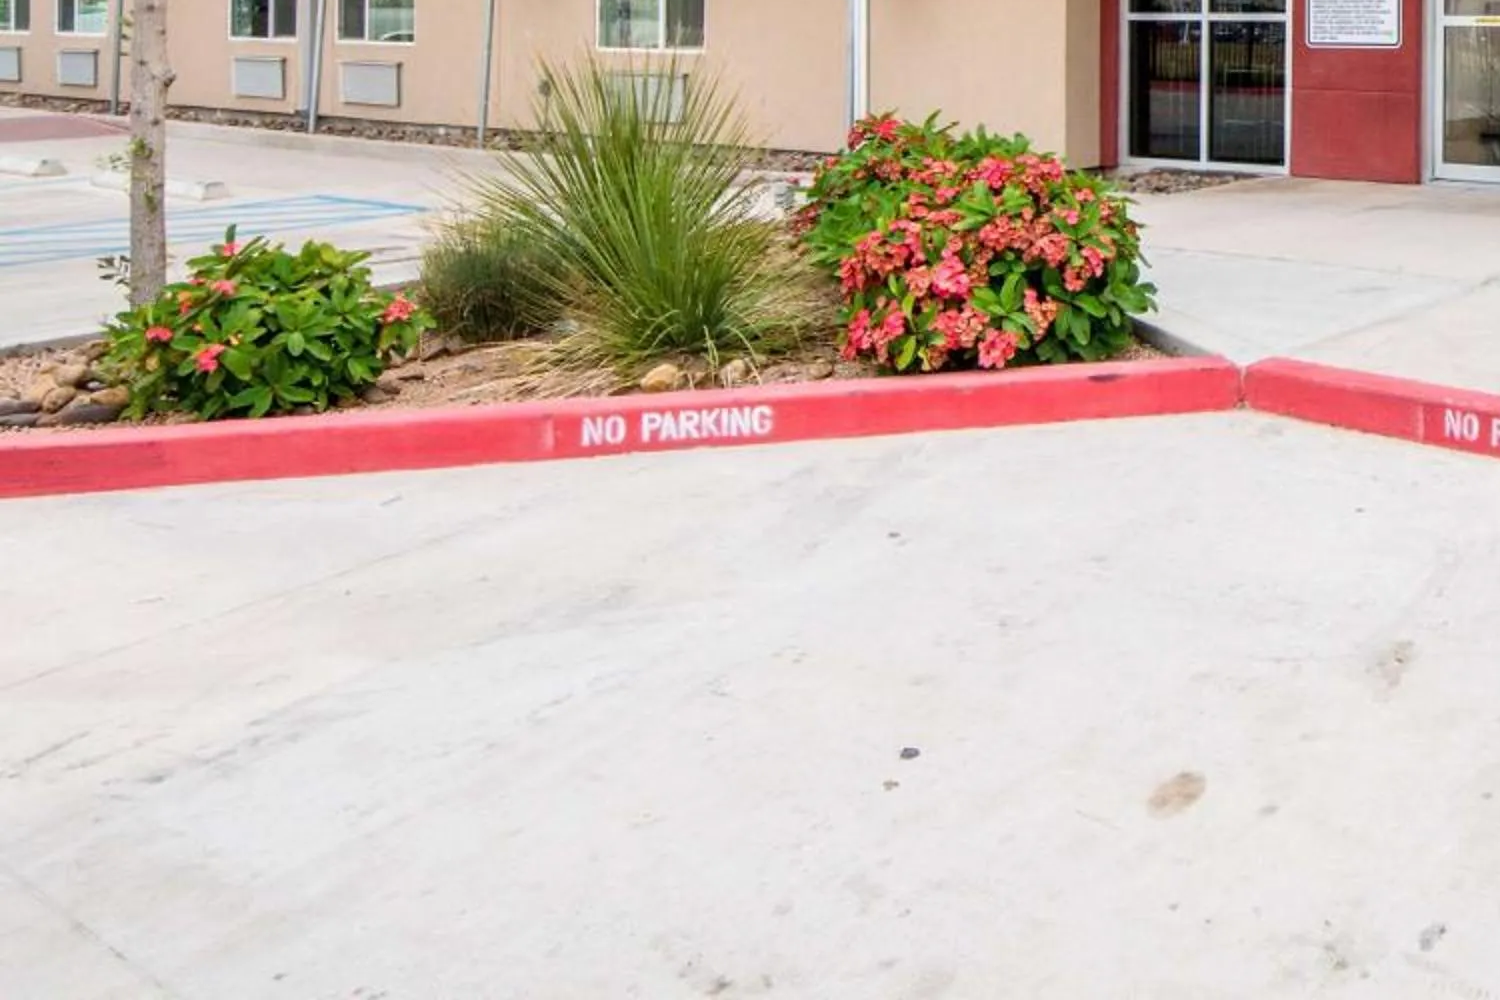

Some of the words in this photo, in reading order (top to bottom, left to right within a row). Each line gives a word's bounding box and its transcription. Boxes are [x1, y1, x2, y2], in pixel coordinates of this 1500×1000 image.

[581, 416, 625, 446] NO
[642, 406, 772, 441] PARKING
[1444, 409, 1479, 441] NO
